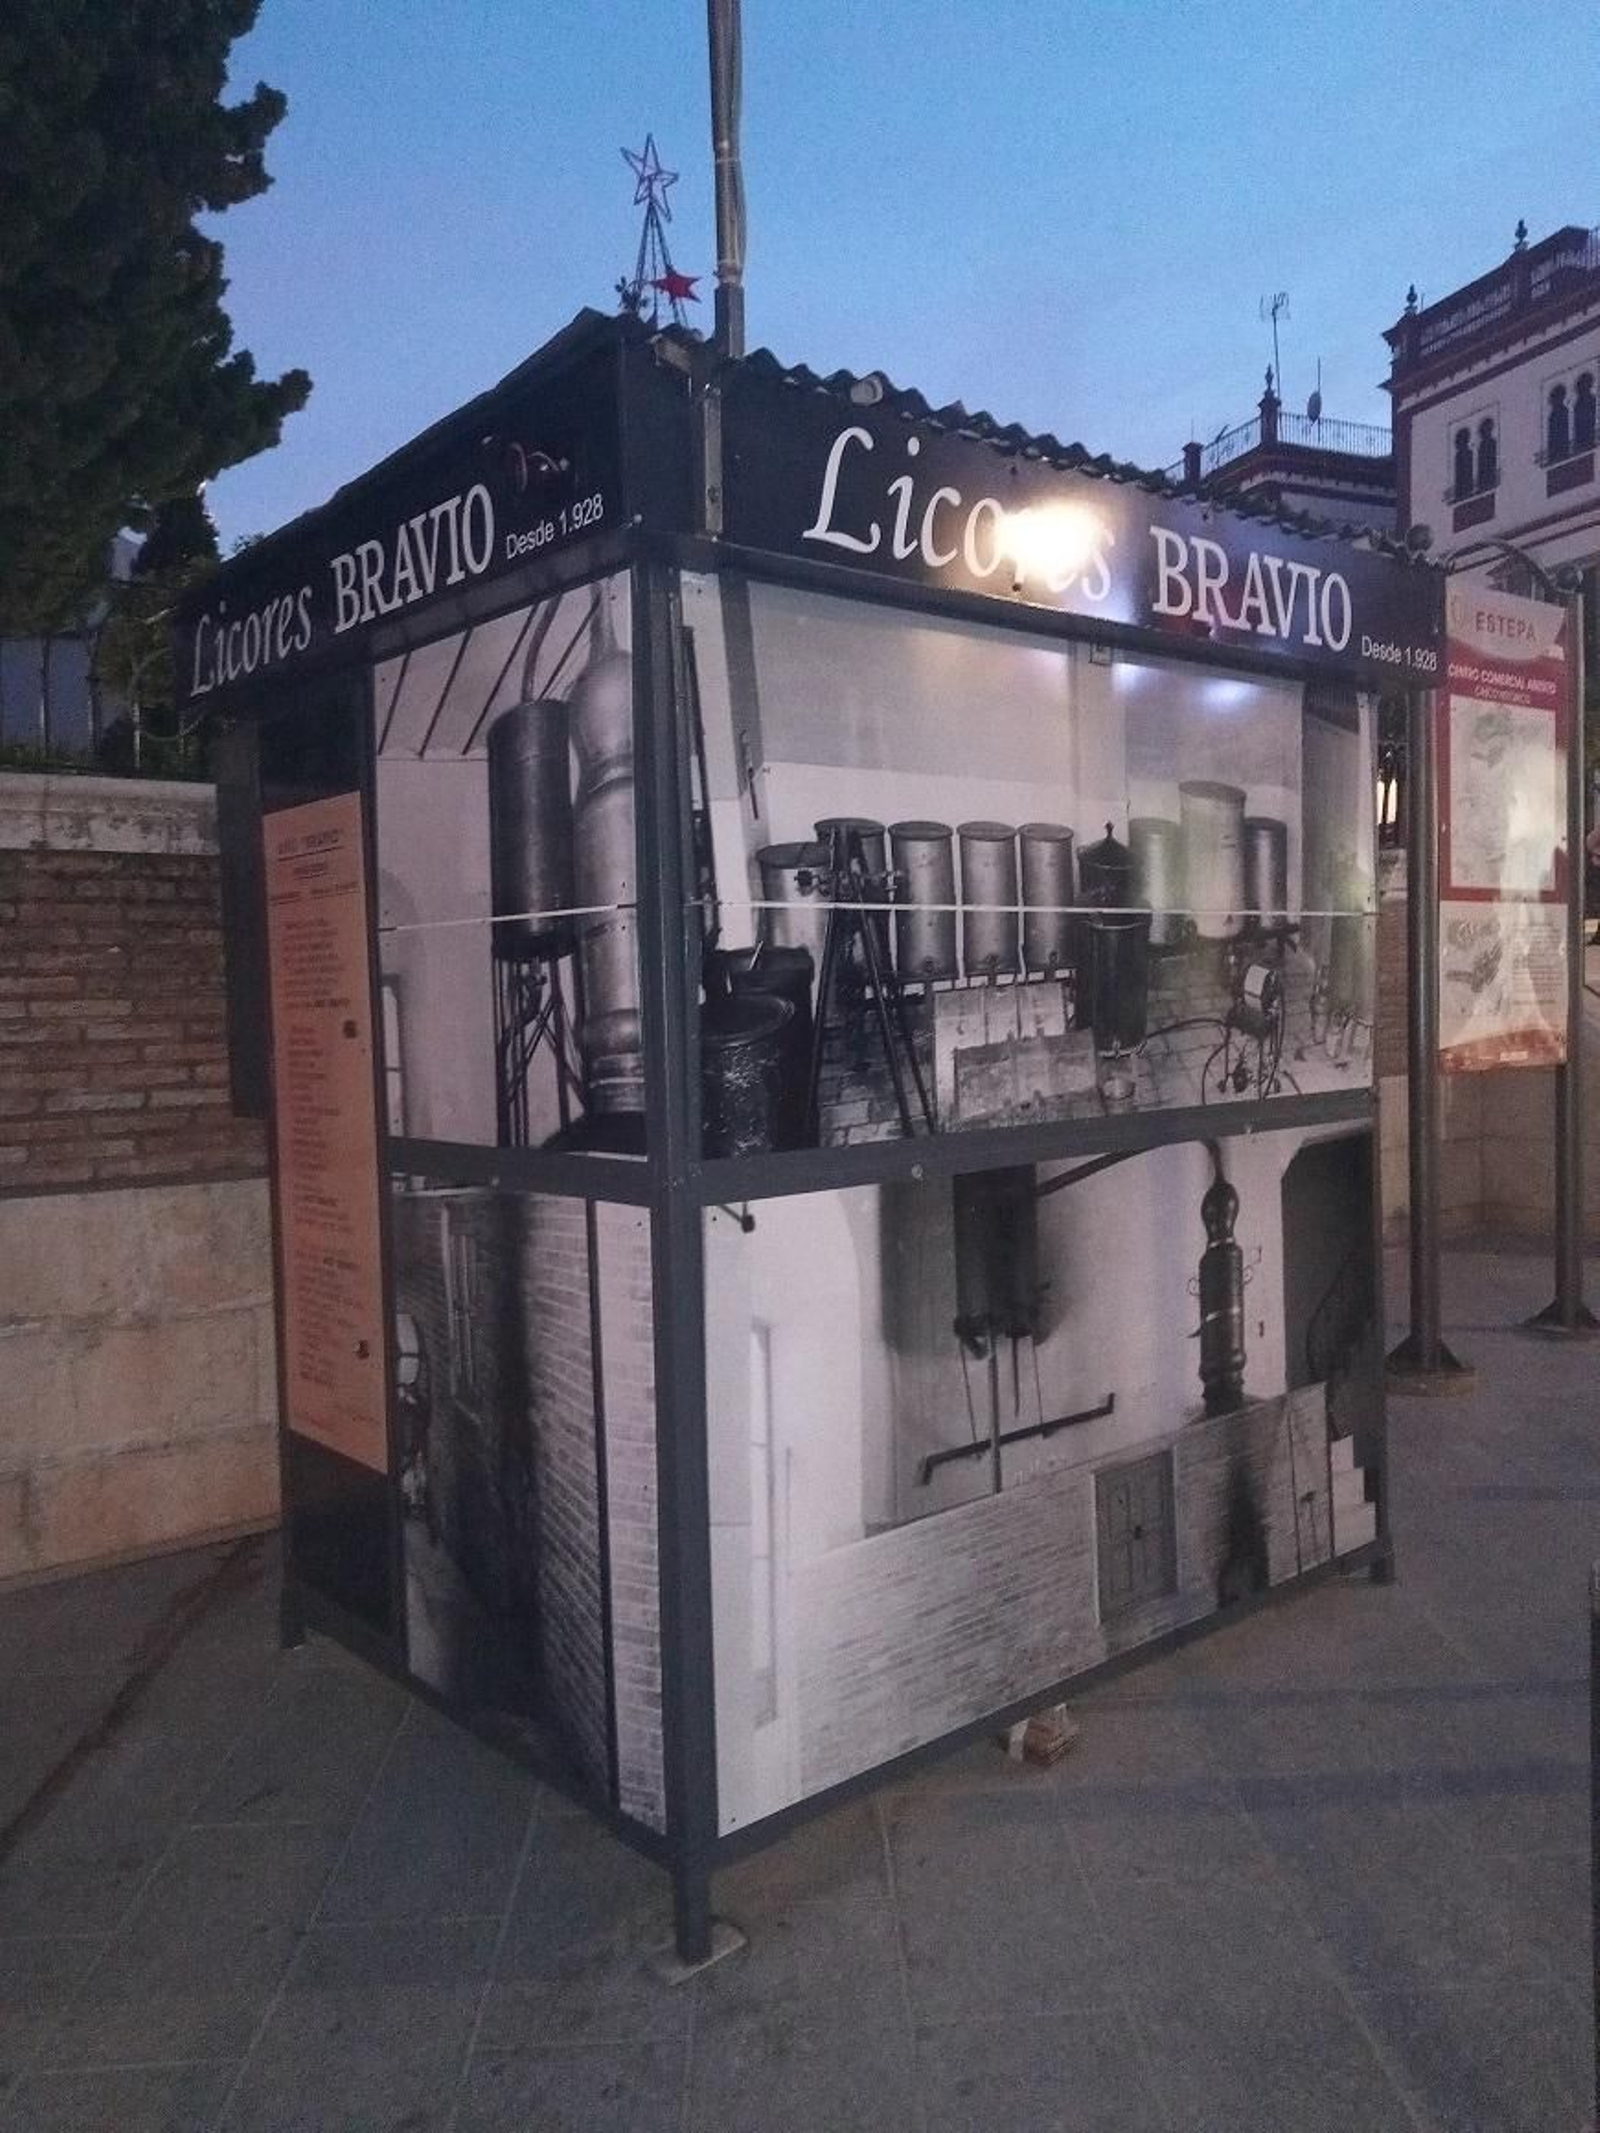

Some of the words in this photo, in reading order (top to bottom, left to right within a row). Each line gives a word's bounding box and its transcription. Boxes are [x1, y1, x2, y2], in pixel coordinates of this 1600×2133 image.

[505, 519, 554, 560] Desde
[557, 493, 604, 538] 1.928
[803, 426, 1115, 602] Licos
[1150, 525, 1353, 652] BRAVIO
[190, 584, 312, 698] Licores
[331, 483, 495, 634] BRAVIO
[1361, 634, 1402, 665] Desde
[1404, 645, 1437, 672] 1.928
[1475, 610, 1537, 642] ESTEPA
